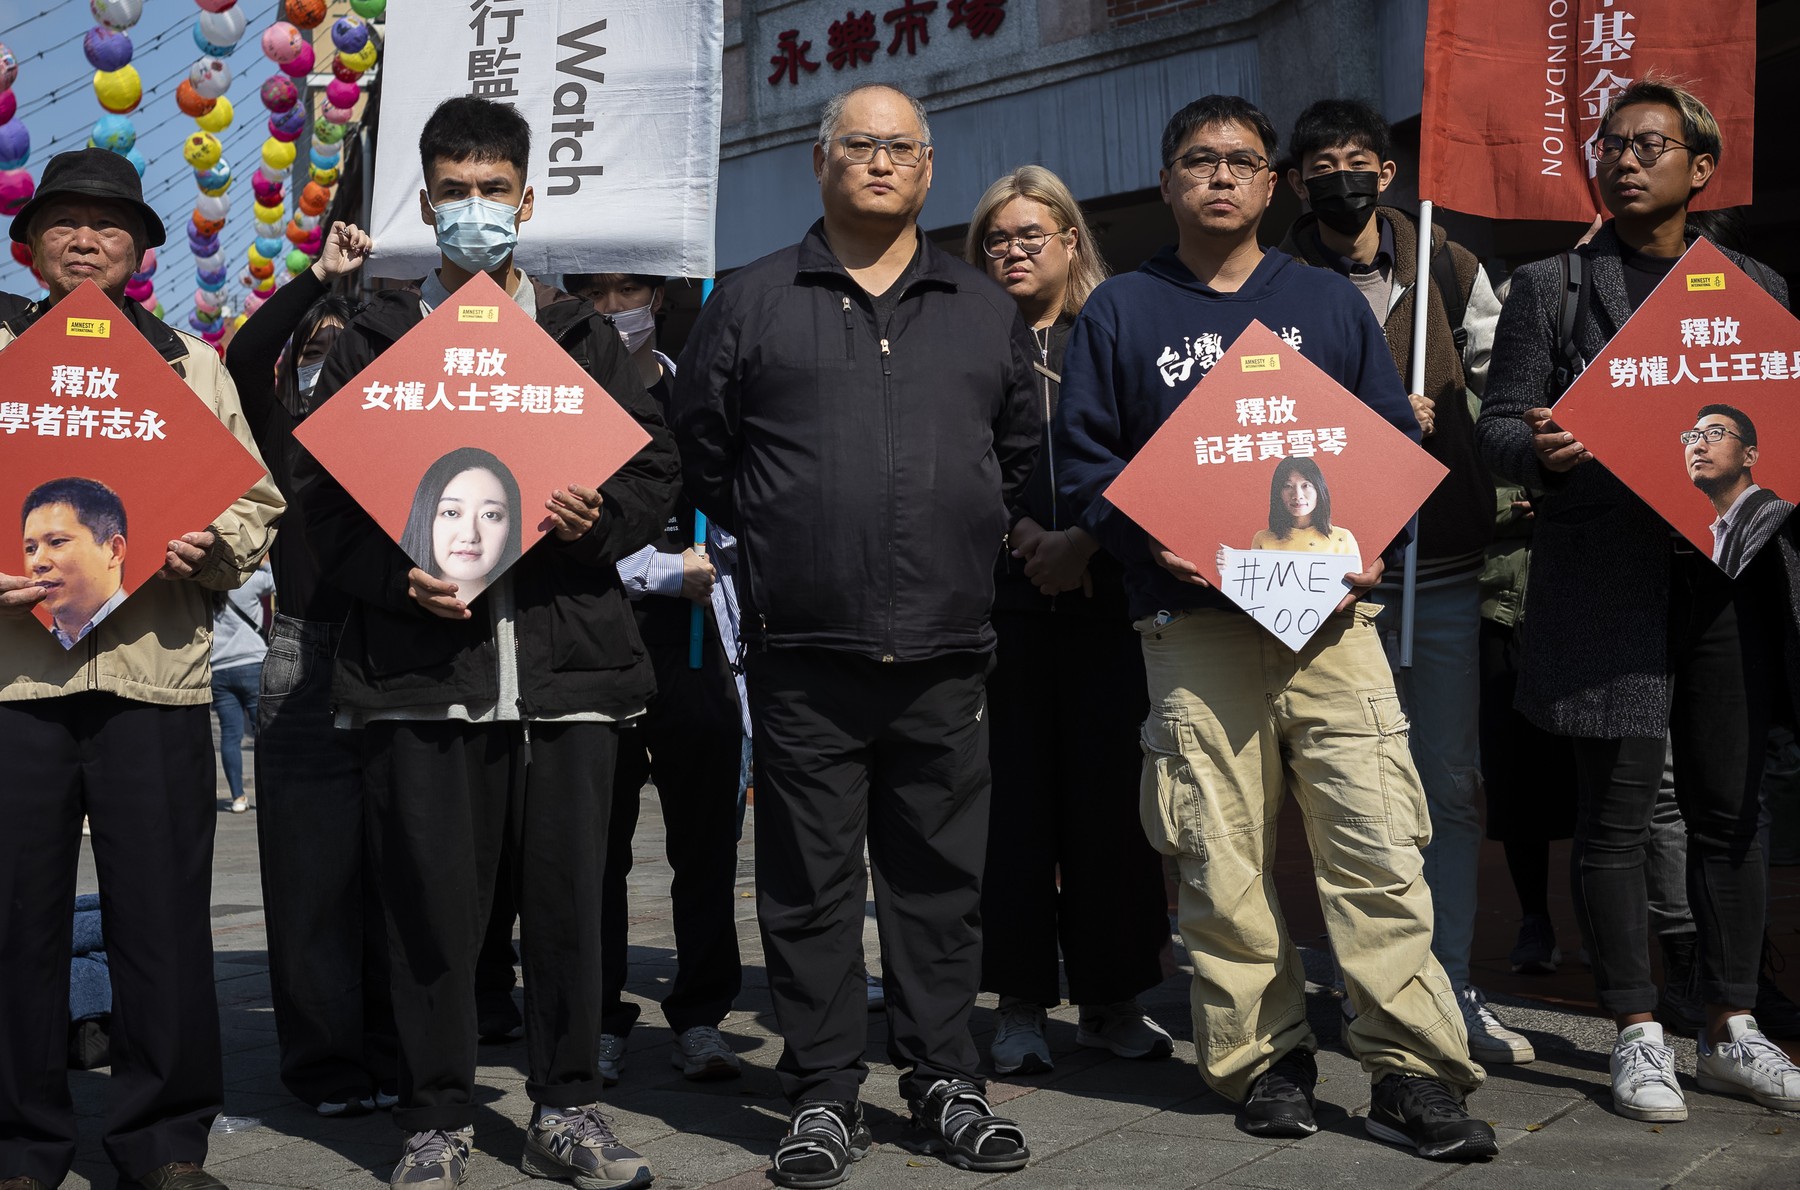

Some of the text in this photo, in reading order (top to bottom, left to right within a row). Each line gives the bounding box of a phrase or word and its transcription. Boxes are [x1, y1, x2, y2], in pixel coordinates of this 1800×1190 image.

[466, 0, 524, 109] 行監
[547, 18, 607, 196] Watch
[1541, 0, 1568, 177] OUNDATION
[1579, 0, 1636, 180] 基金
[1680, 316, 1741, 348] 釋放
[443, 347, 507, 377] 釋放
[51, 364, 120, 400] 釋放
[361, 381, 584, 414] 女權人士李翹楚
[0, 401, 167, 441] 學者許志永
[1235, 395, 1298, 427] 釋放
[1193, 427, 1348, 465] 記者黃雪琴
